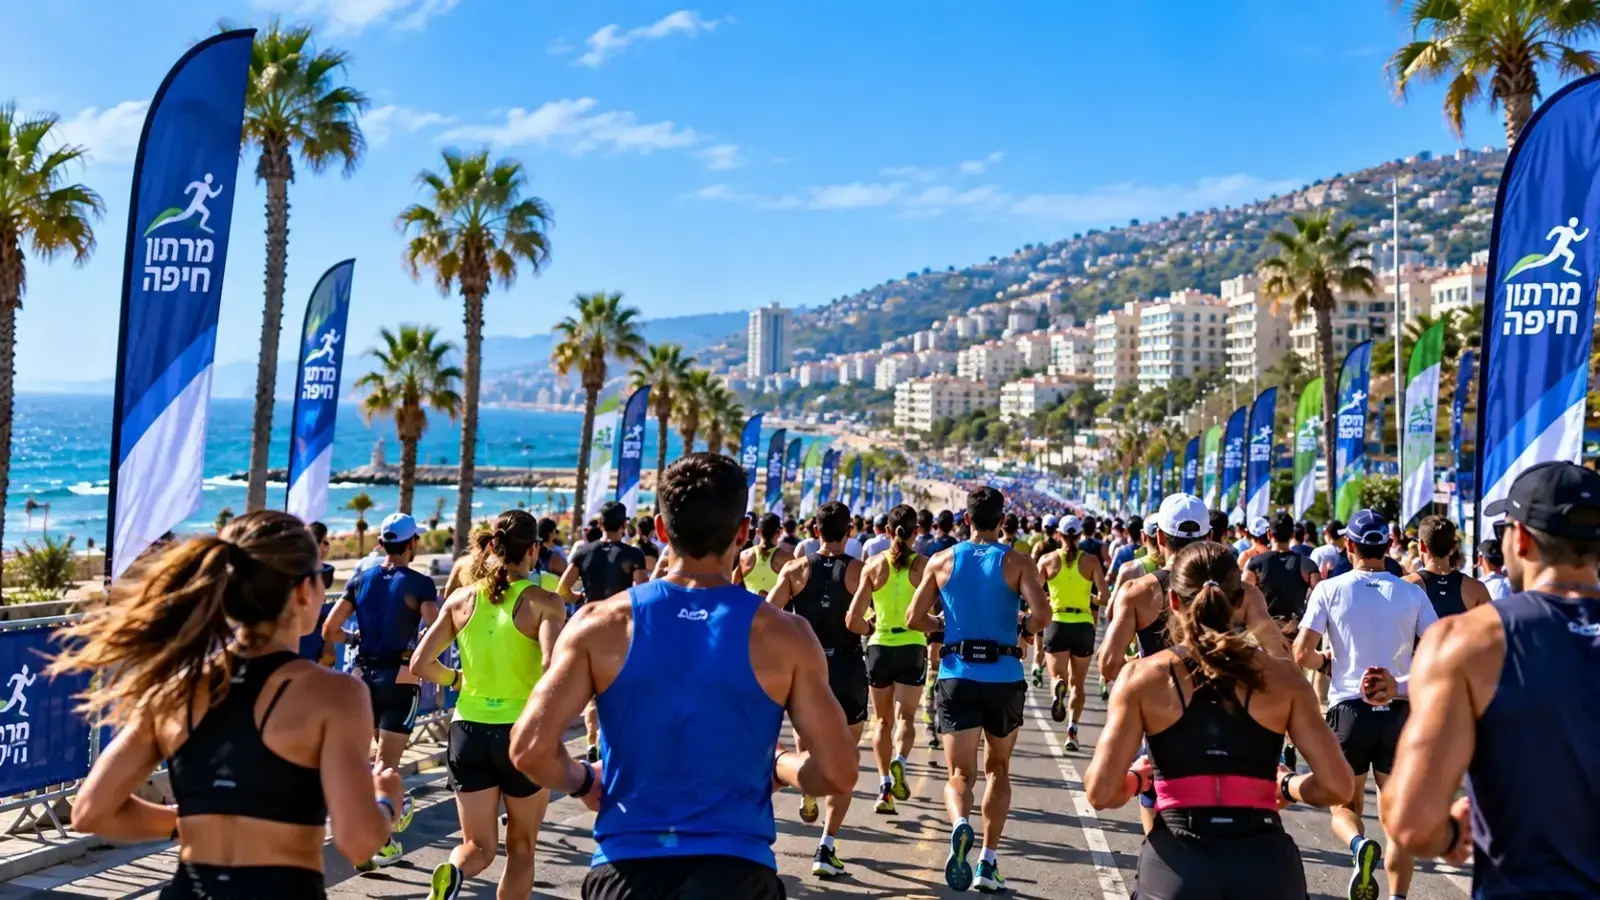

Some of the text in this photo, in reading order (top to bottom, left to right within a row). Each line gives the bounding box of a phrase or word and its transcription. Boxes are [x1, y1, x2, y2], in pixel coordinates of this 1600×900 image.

[145, 237, 215, 266] מרתון
[142, 266, 211, 293] חיפה
[1505, 281, 1581, 311] מרתון
[1502, 309, 1578, 335] חיפה
